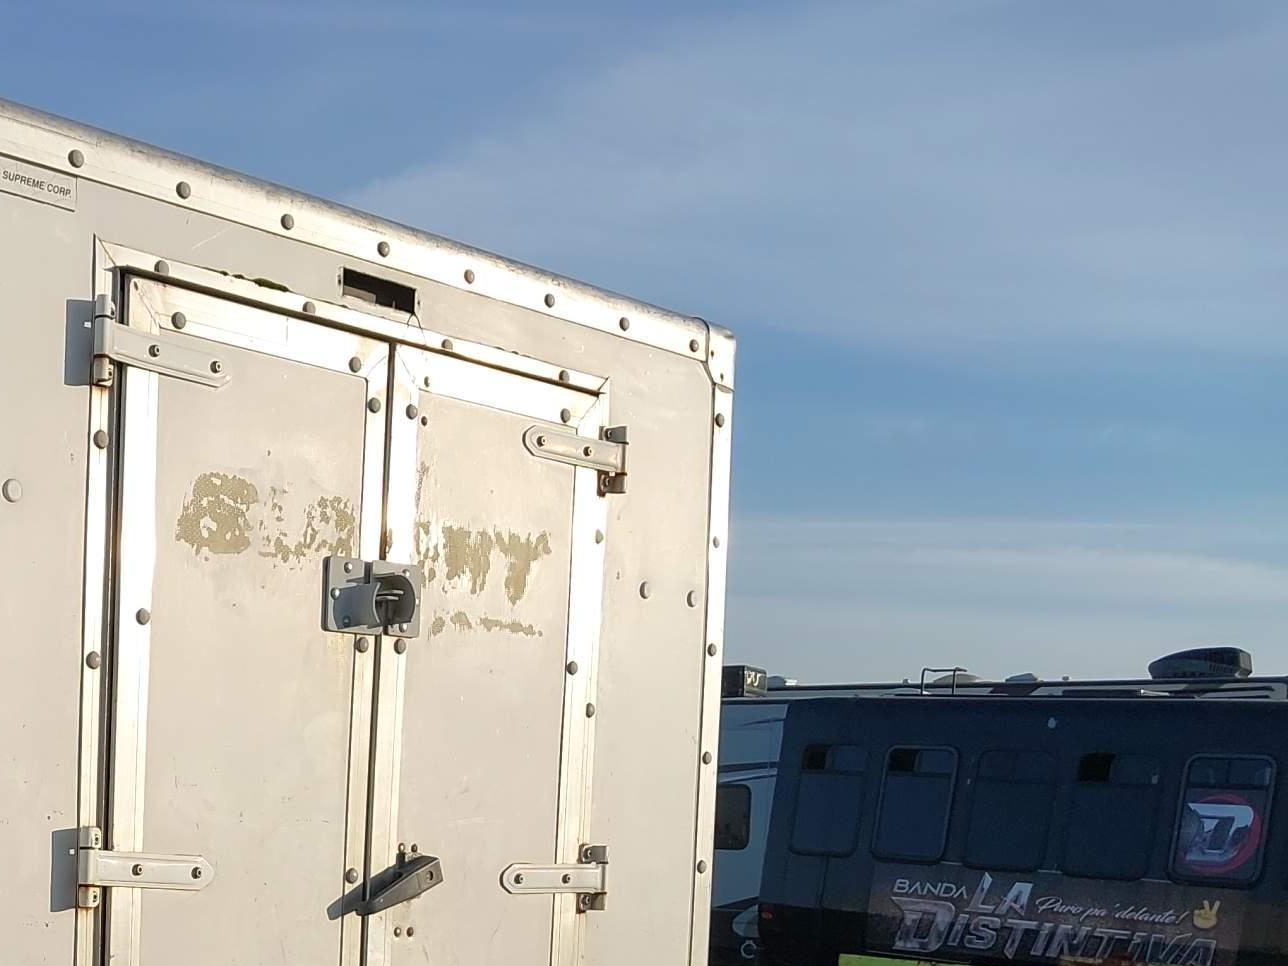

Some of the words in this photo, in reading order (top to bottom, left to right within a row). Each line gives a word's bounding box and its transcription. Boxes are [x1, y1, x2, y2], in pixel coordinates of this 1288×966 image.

[2, 170, 46, 191] SUPREME
[893, 879, 968, 899] BANDA
[965, 871, 1034, 917] LA
[1035, 896, 1083, 914] Puro
